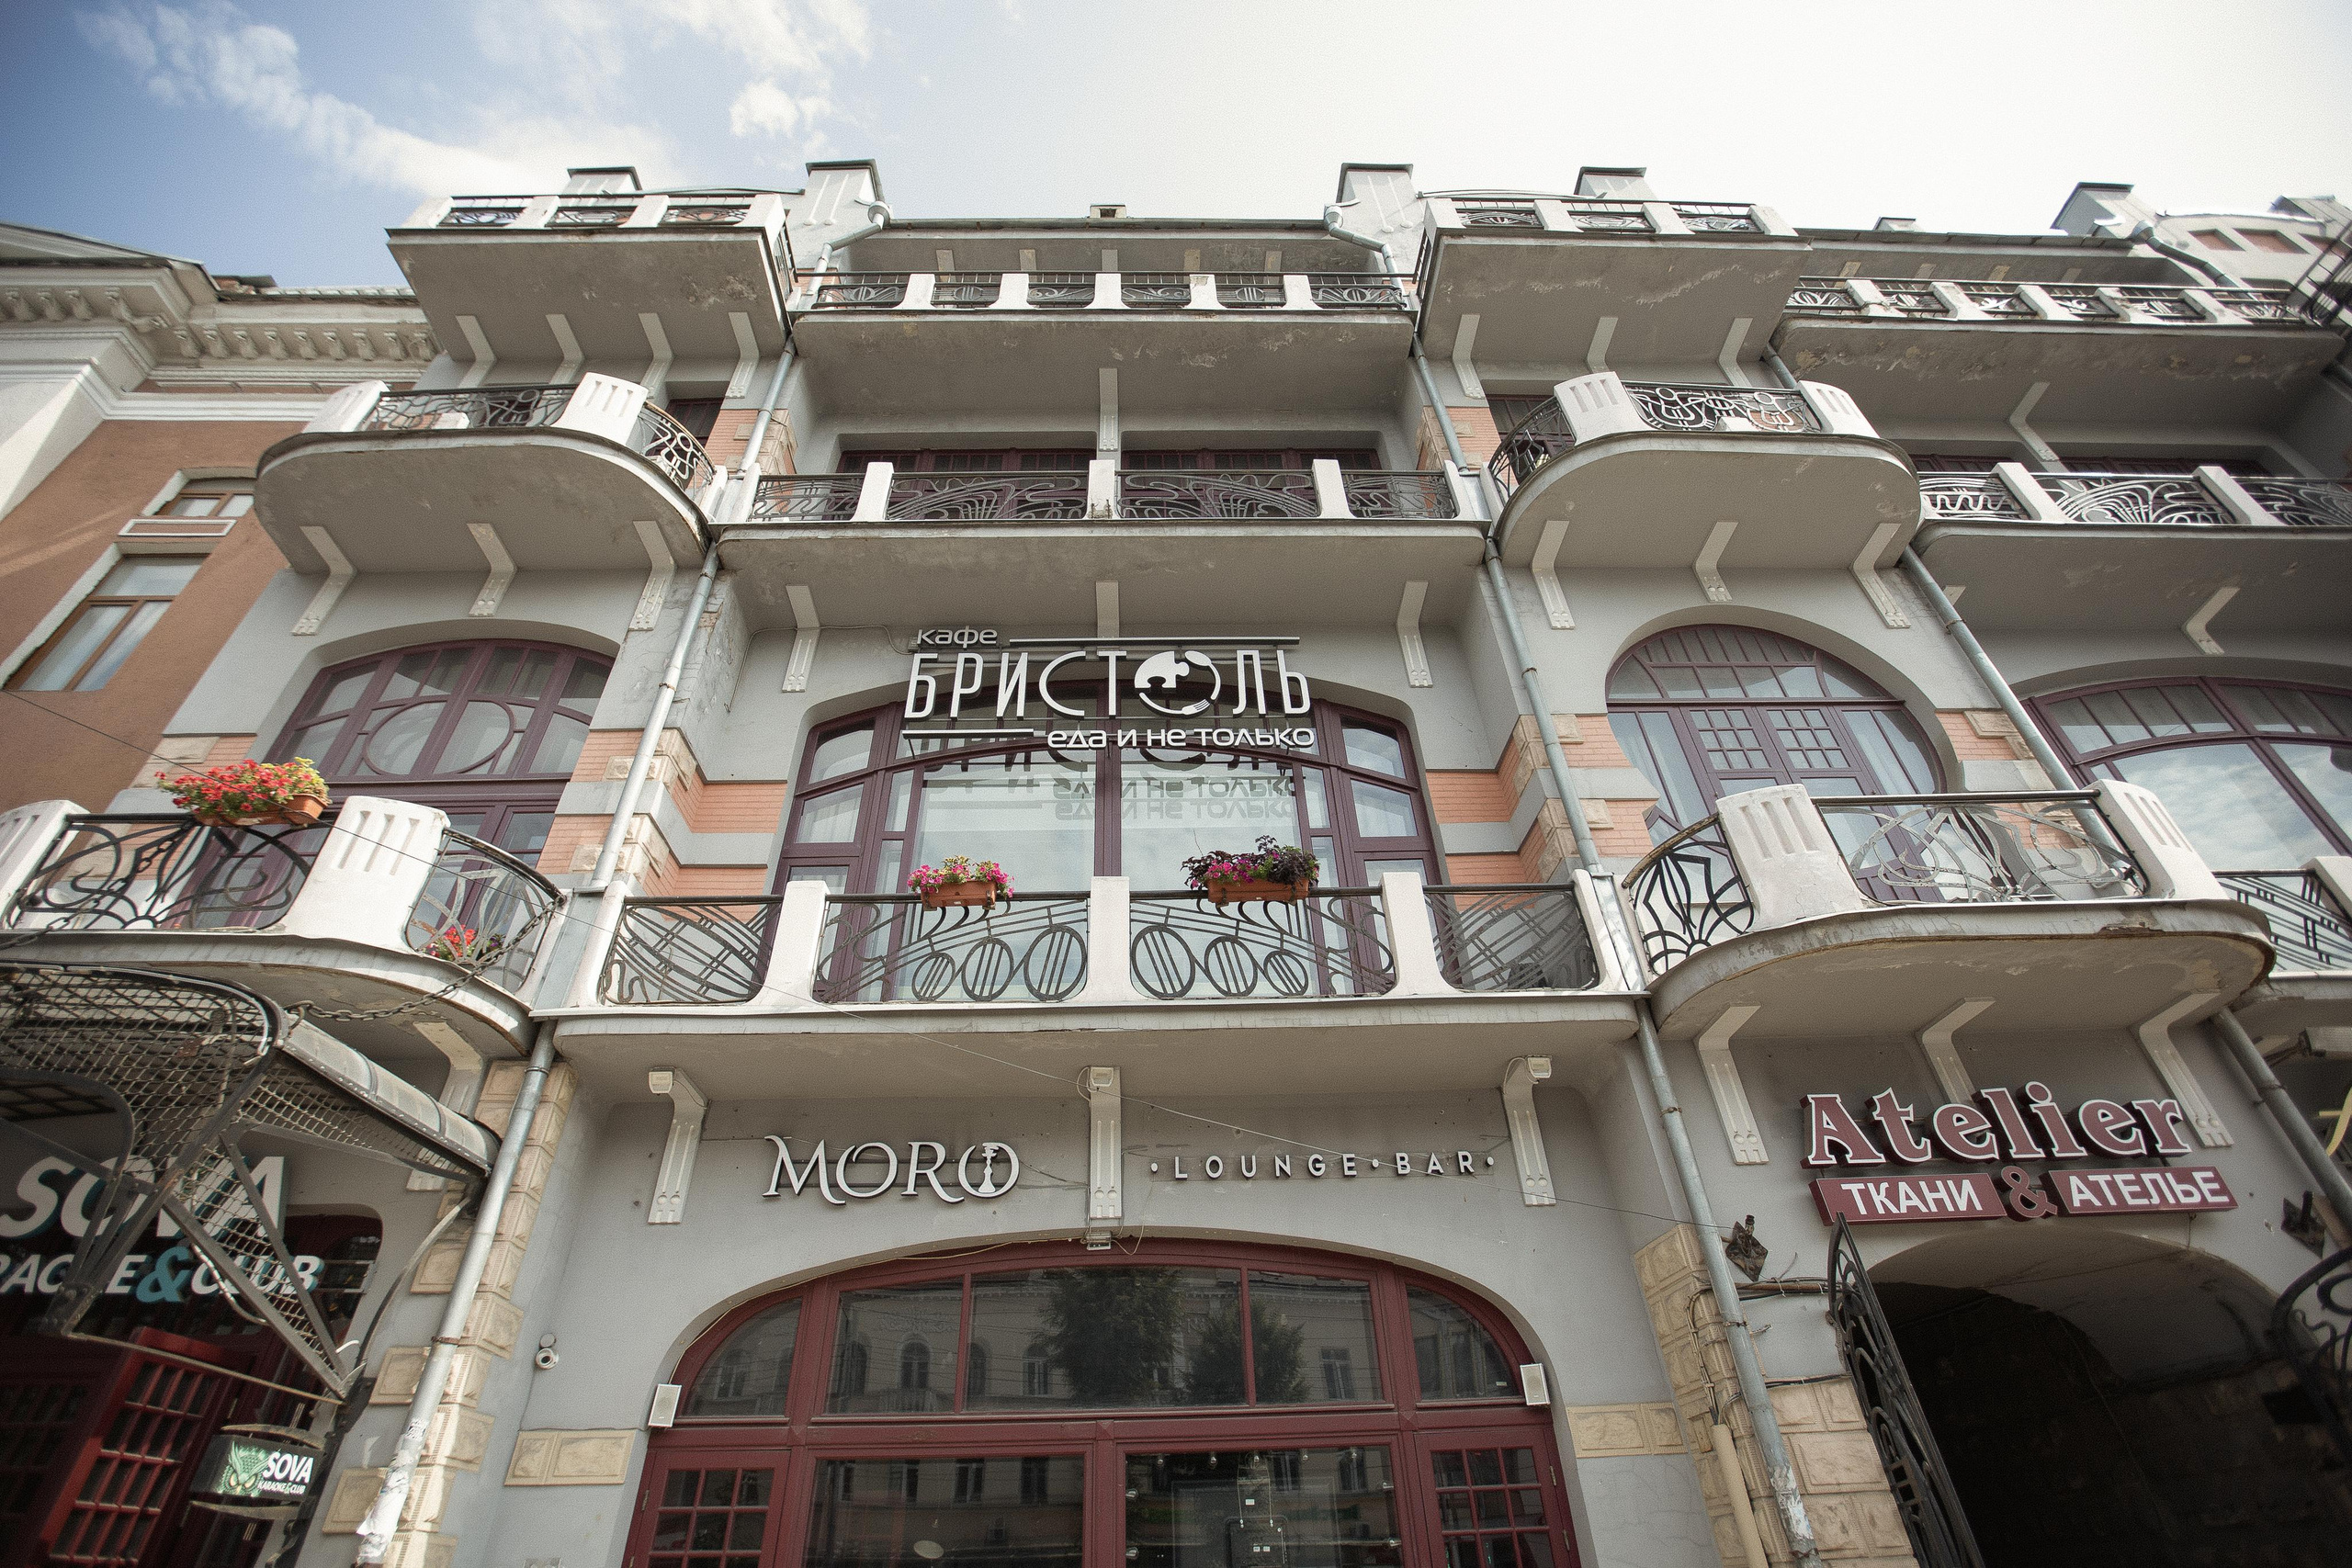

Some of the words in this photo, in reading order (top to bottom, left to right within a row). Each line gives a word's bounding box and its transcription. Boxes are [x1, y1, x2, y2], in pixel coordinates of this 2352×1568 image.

[917, 626, 998, 648] кафе
[904, 650, 1311, 718] БРИСТОЛЬ
[1047, 731, 1107, 748] еда
[1196, 728, 1315, 746] только
[1804, 1081, 2193, 1166] Atelier
[762, 1135, 1020, 1204] MORO
[1841, 1180, 1984, 1214] ТКАНИ
[2001, 1166, 2058, 1219] &
[2070, 1171, 2230, 1207] АТЕЛЬЕ
[263, 1451, 314, 1483] SOVA
